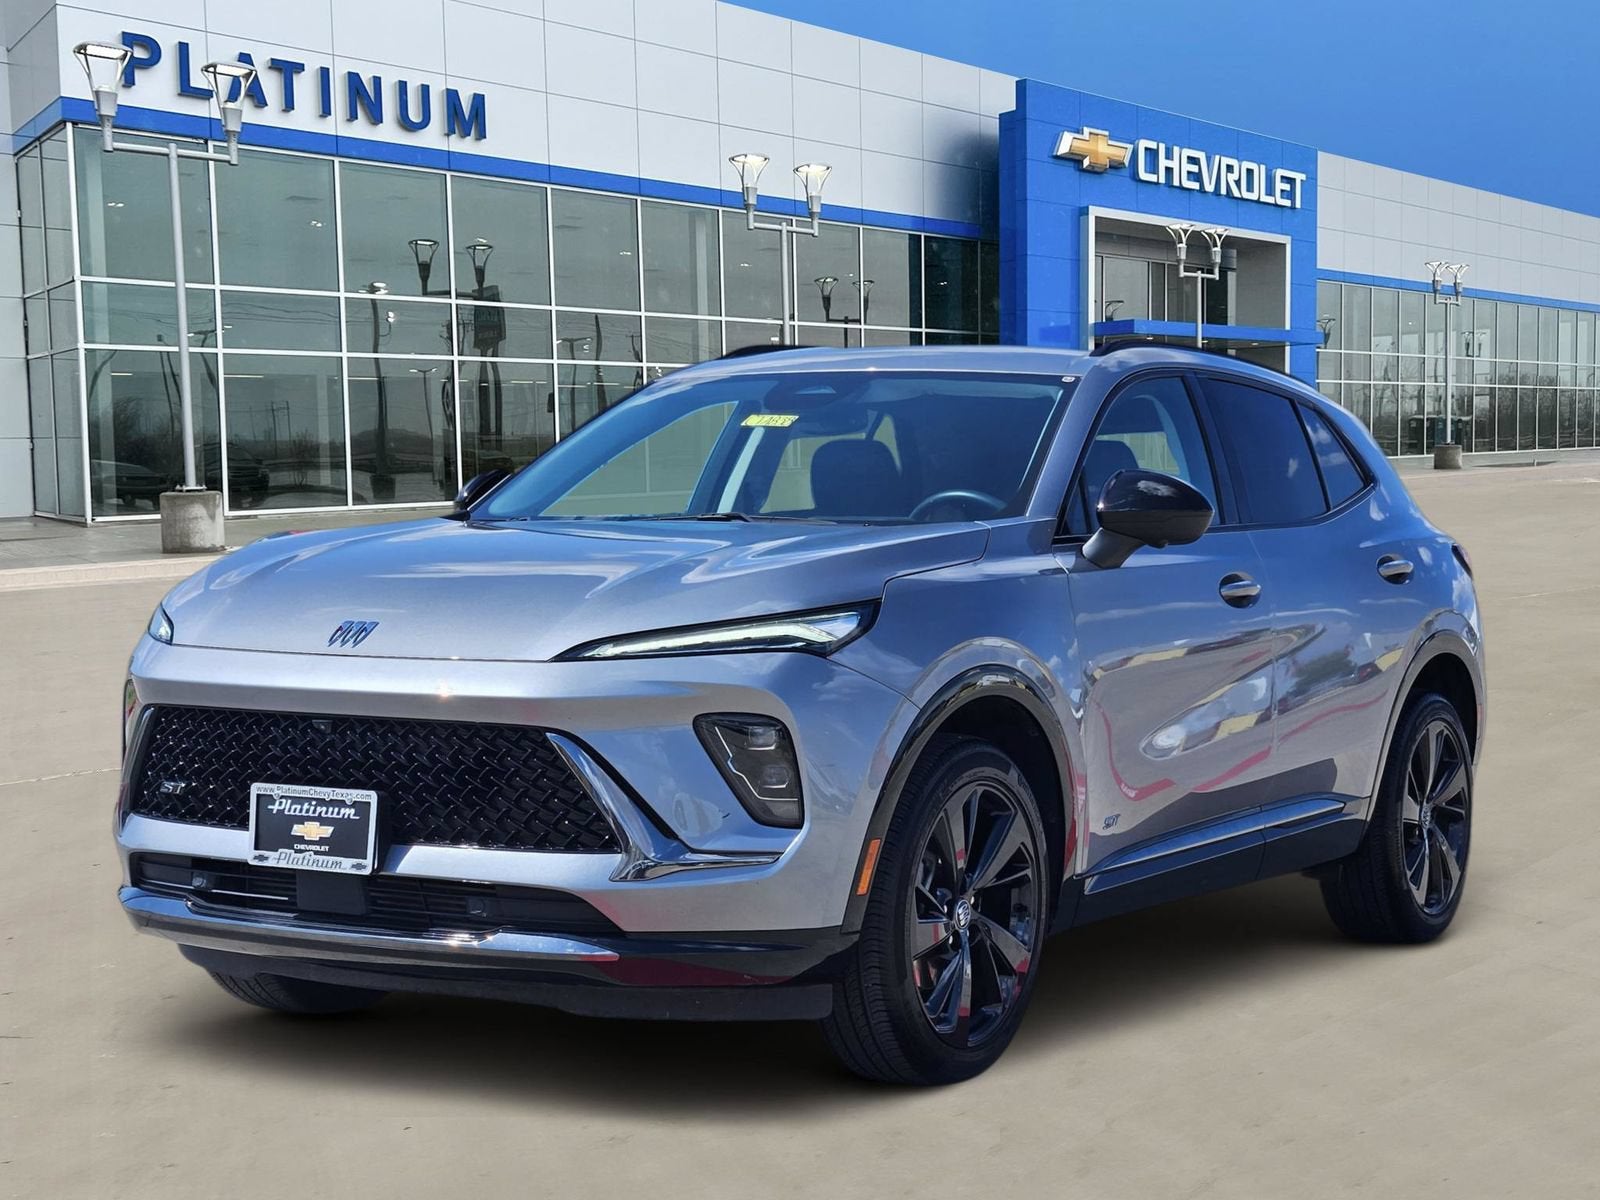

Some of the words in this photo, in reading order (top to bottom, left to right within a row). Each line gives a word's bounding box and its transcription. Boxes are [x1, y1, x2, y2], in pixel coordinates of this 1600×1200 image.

[121, 31, 487, 140] PLATINUM
[1137, 138, 1306, 208] CHEVROLET
[160, 781, 185, 793] ST
[256, 785, 372, 800] www.PlatinumChevyTexas.com
[267, 798, 360, 819] Platinum
[294, 843, 329, 852] CHEVROLET
[273, 851, 347, 870] Platinum
